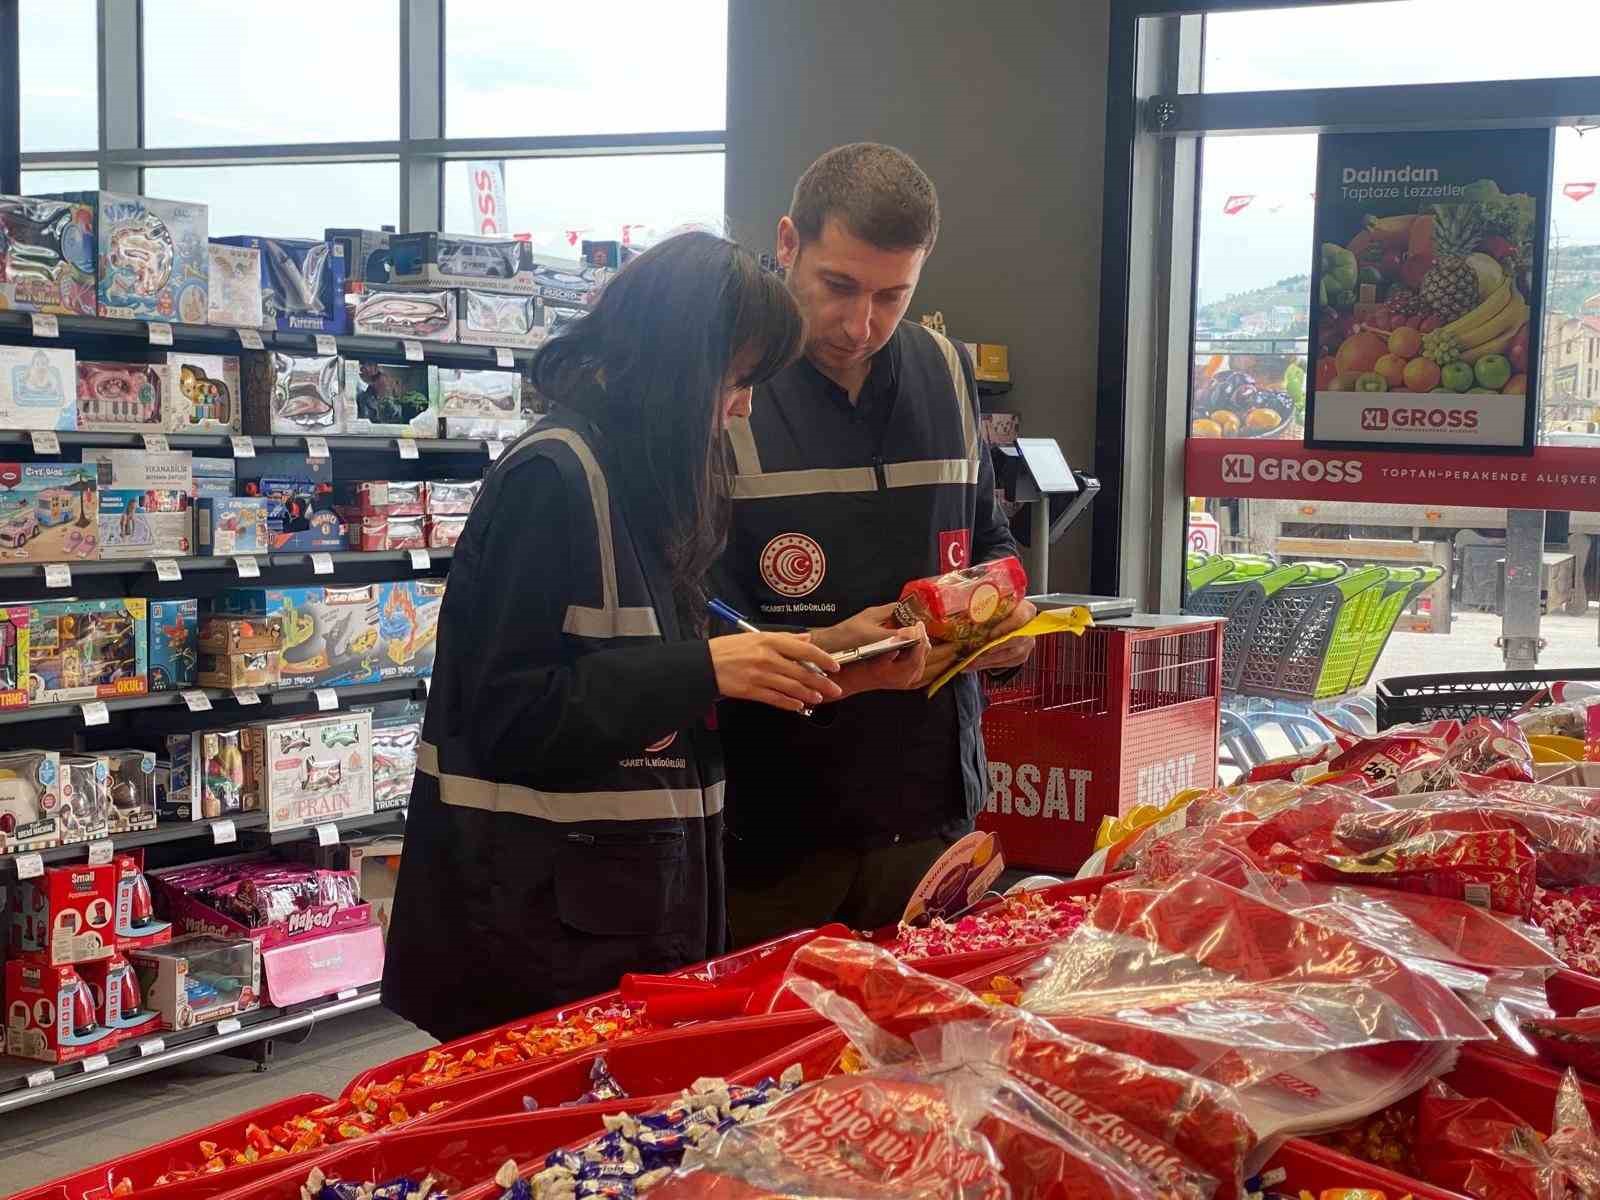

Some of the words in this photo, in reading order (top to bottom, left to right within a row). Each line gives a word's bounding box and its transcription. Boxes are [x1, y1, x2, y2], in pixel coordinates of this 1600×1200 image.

[1342, 165, 1439, 183] Dalından
[1341, 186, 1399, 201] Taptaze
[1403, 184, 1466, 198] Lezzetler
[1363, 410, 1387, 428] XL
[1391, 408, 1478, 428] GROSS
[1224, 456, 1252, 480] XL
[1259, 458, 1363, 483] GROSS
[1381, 468, 1529, 483] TOPTAN-PERAKENDE
[983, 761, 1093, 823] RSAT
[292, 793, 352, 818] TRAIN
[71, 871, 95, 884] Small
